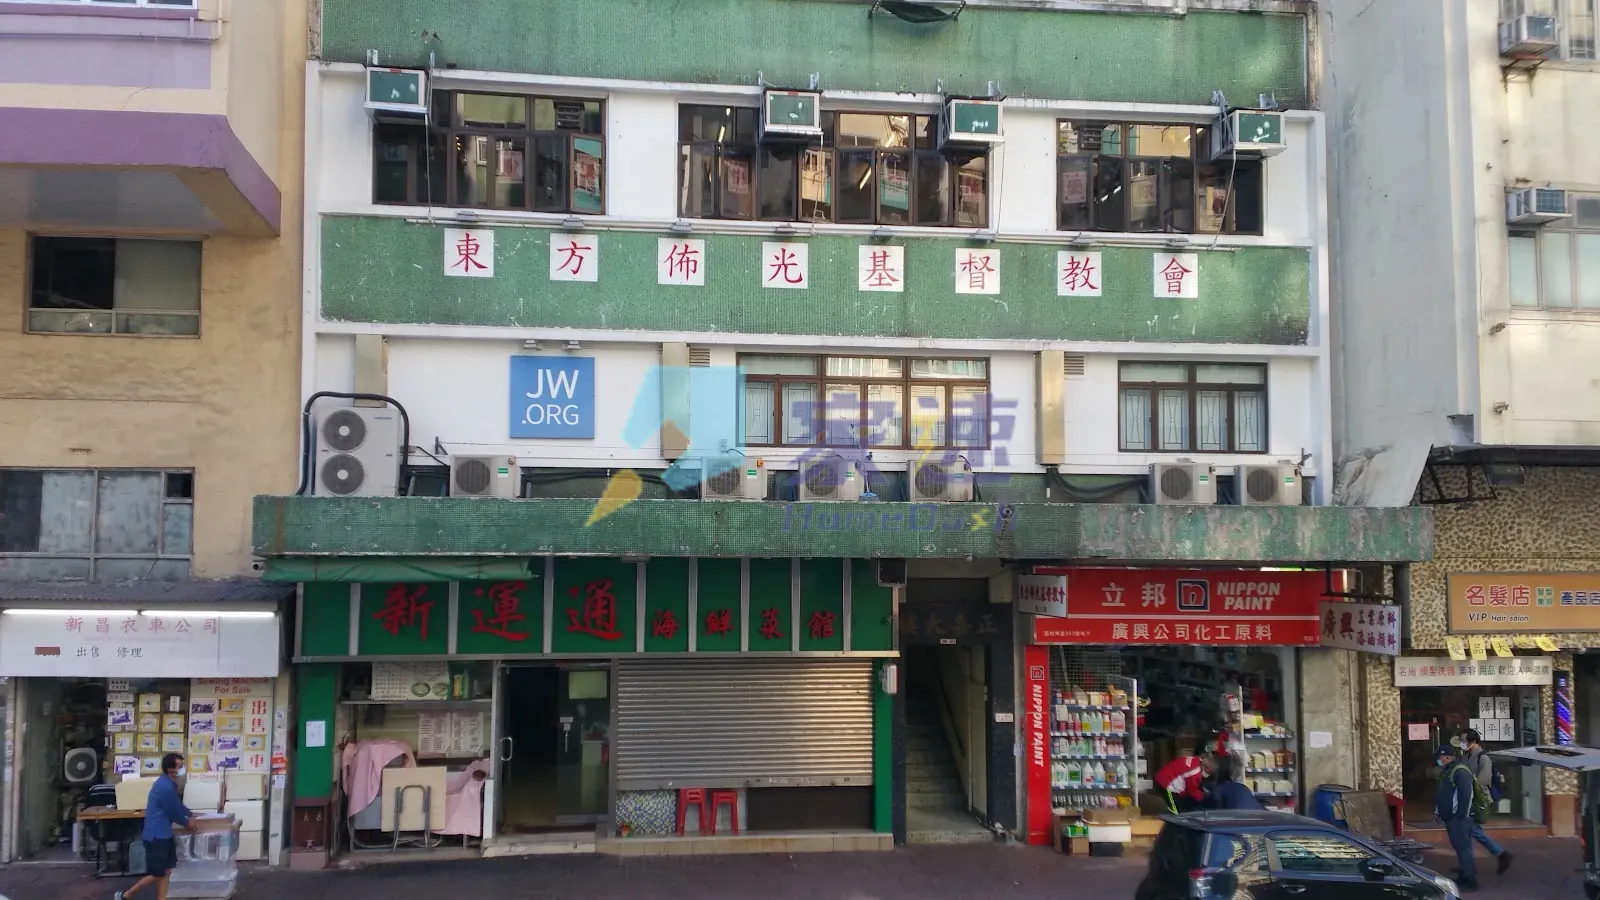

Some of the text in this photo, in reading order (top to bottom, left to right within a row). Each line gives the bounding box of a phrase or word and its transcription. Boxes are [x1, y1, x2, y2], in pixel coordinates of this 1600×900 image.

[450, 233, 1193, 294] 東方佈光基督教會
[526, 369, 579, 399] JW
[521, 404, 580, 426] .ORG
[1102, 581, 1166, 609] 立邦
[1216, 581, 1281, 596] NIPPON
[1465, 585, 1530, 607] 名髮店
[373, 580, 836, 642] 新運通 海鮮菜館
[1224, 596, 1275, 611] PAINT
[65, 616, 218, 635] 新昌衣車公司
[1469, 613, 1488, 622] VIP
[1112, 623, 1273, 641] 廣興公司化工原料
[77, 646, 142, 658] 出售 修理
[215, 686, 252, 694] For Sale
[1032, 684, 1044, 768] NIPPON PAINT
